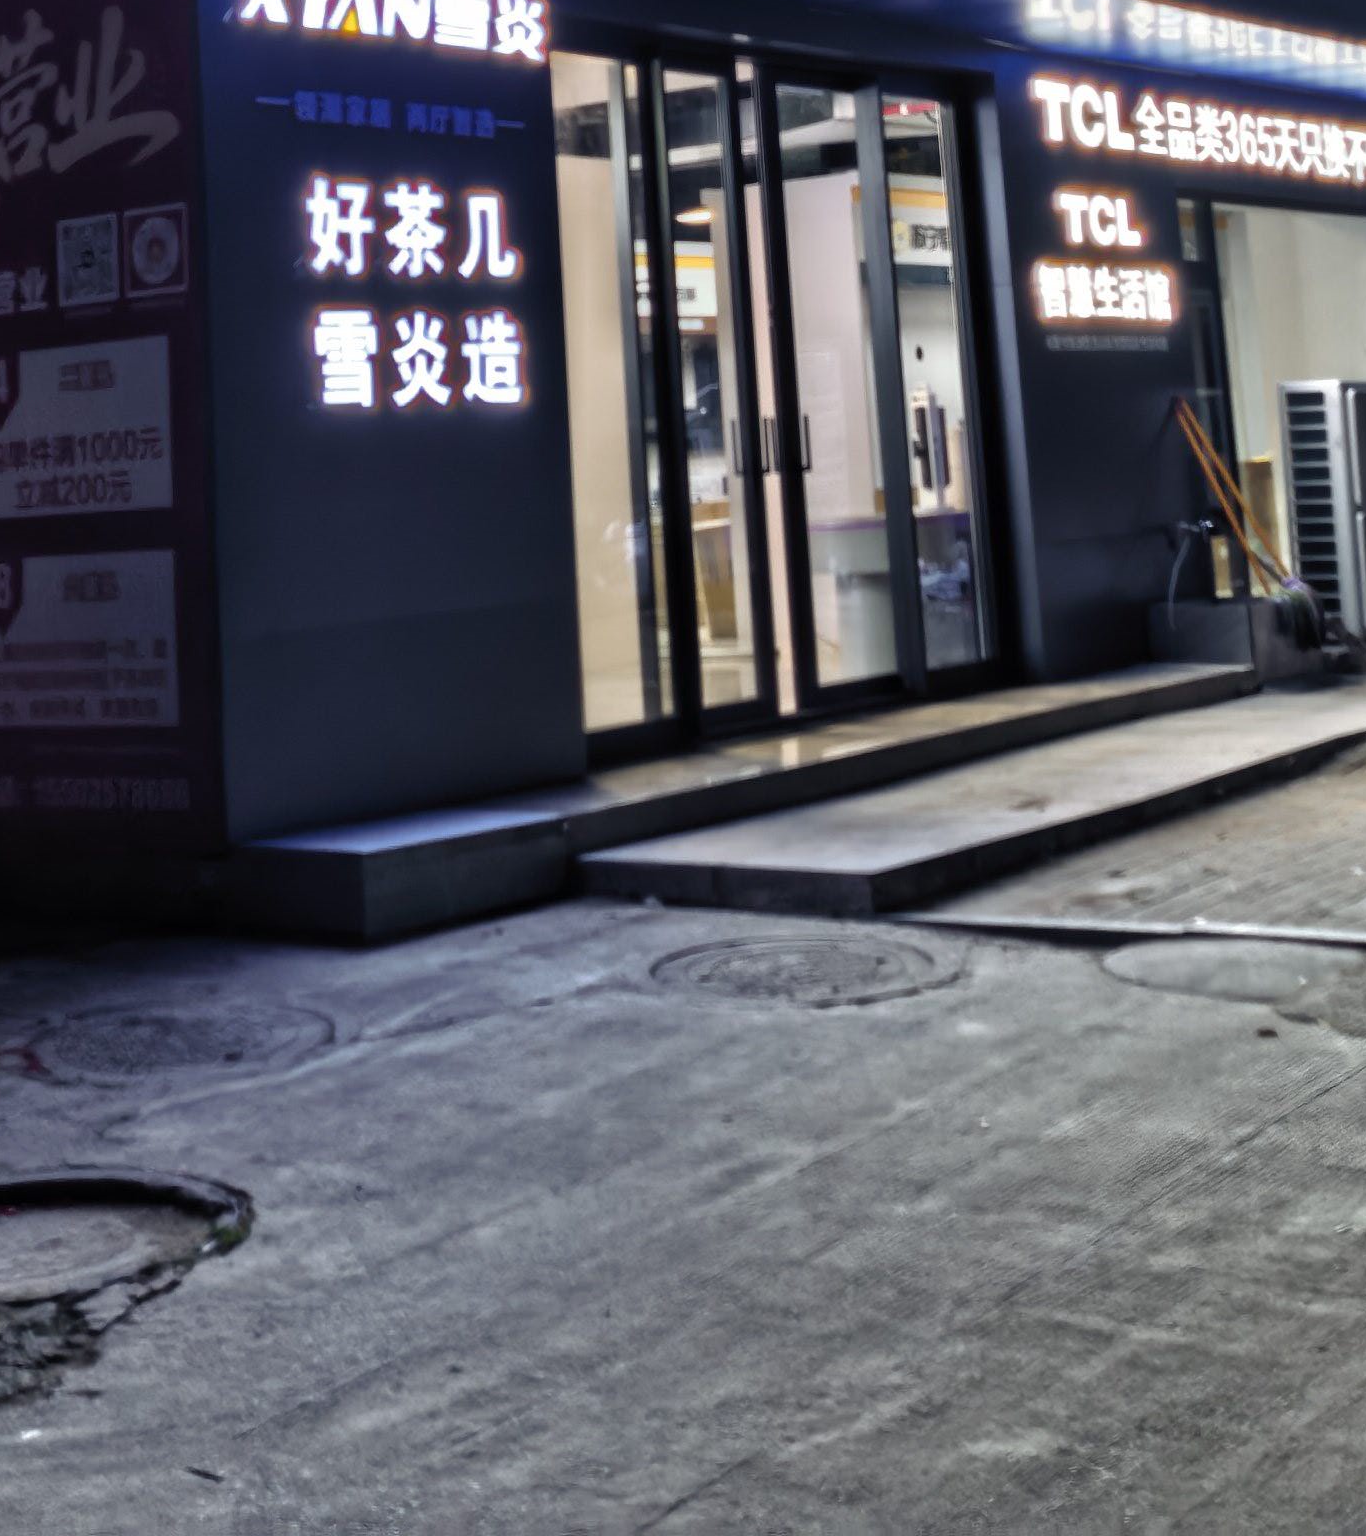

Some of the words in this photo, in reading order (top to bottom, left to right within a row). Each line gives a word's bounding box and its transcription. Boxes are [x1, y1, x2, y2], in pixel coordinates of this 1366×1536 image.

[304, 176, 518, 279] 好茶几
[1057, 191, 1143, 248] TCL
[313, 309, 524, 409] 雪炎造
